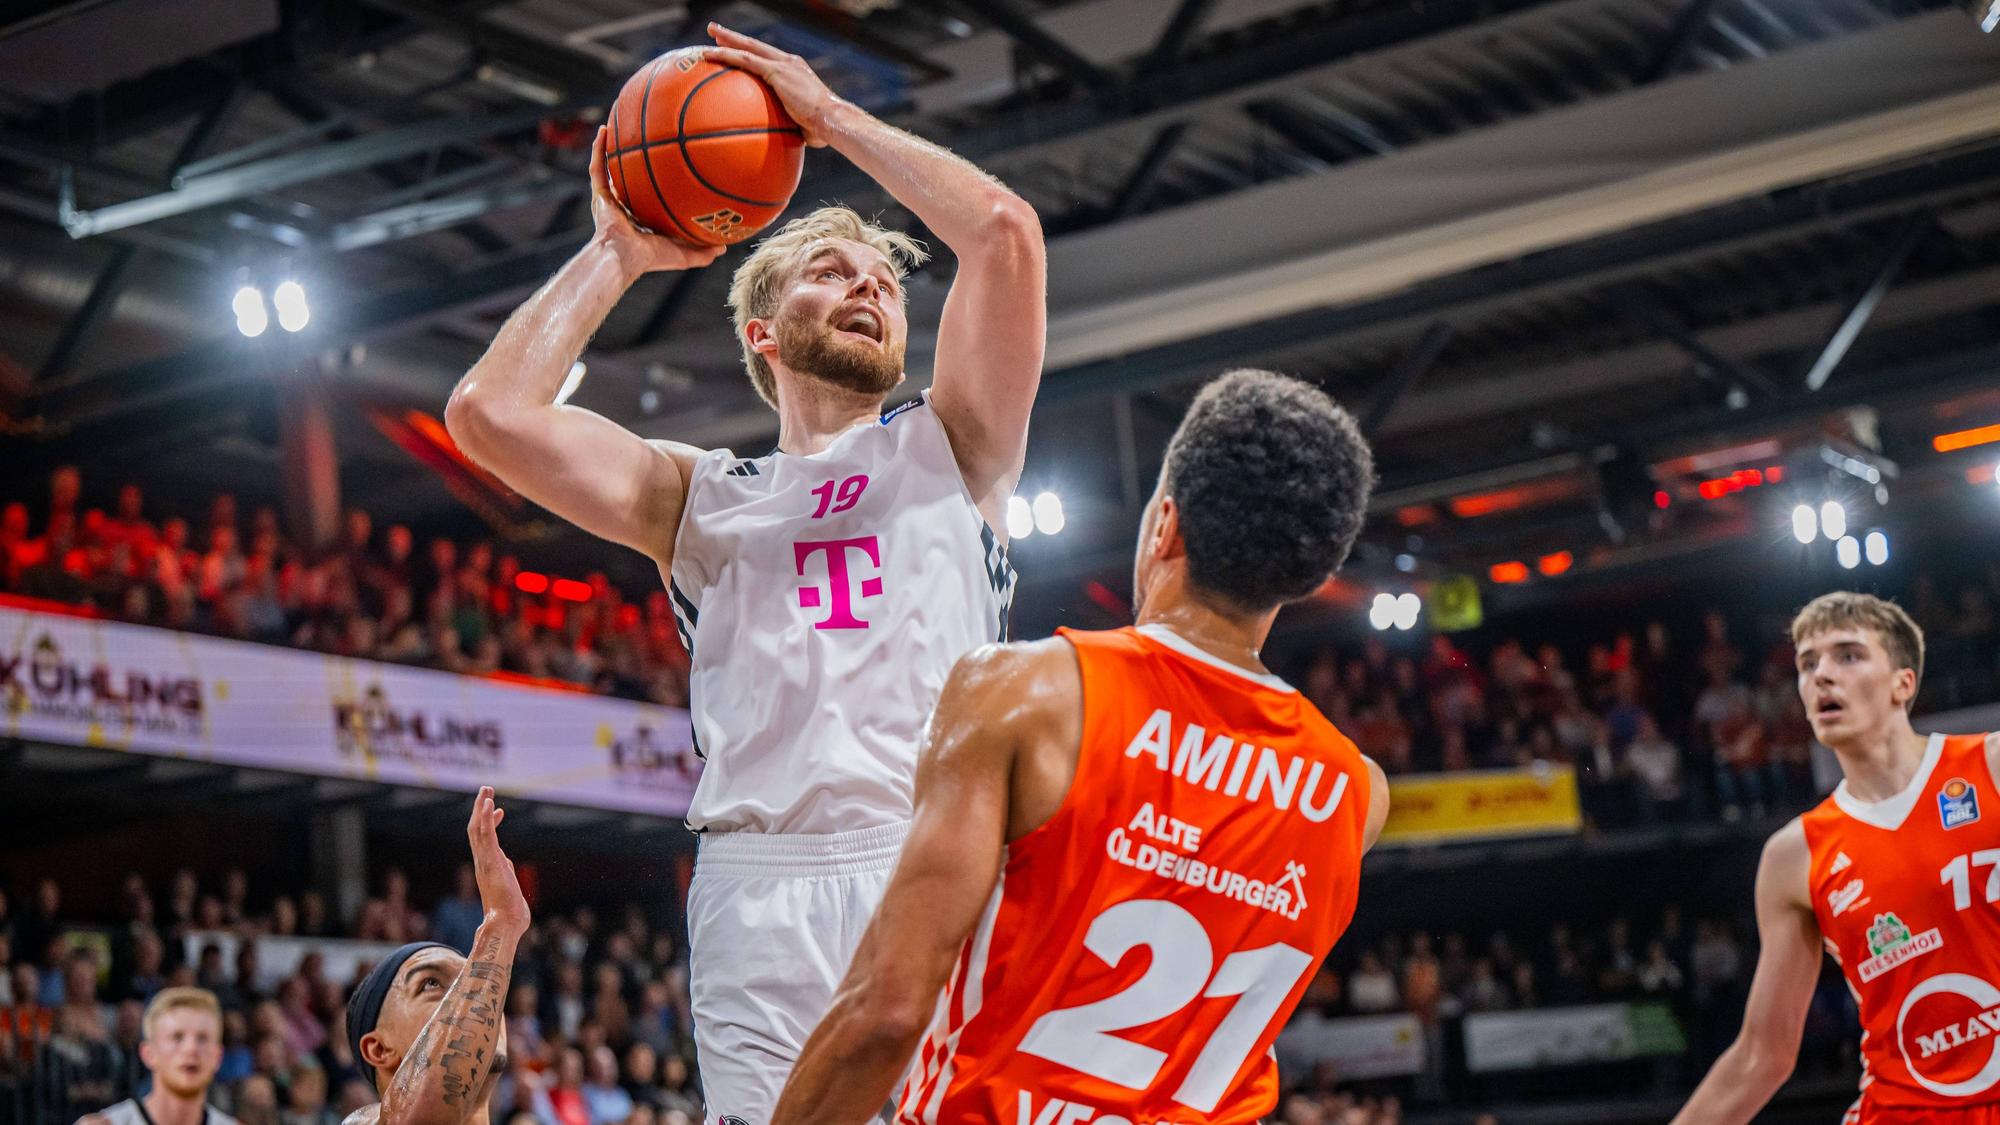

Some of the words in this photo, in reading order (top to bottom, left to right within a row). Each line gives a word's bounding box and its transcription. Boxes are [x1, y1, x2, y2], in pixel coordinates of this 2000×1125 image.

[811, 474, 869, 518] 19
[793, 536, 883, 629] T
[1124, 708, 1349, 823] AMINU
[1128, 802, 1202, 852] ALTE
[1106, 827, 1295, 914] OLDENBURGER
[1940, 848, 2000, 911] 17
[1862, 932, 1938, 977] WIESENHOF
[1016, 899, 1314, 1113] 21
[1915, 1007, 2000, 1058] MIAV
